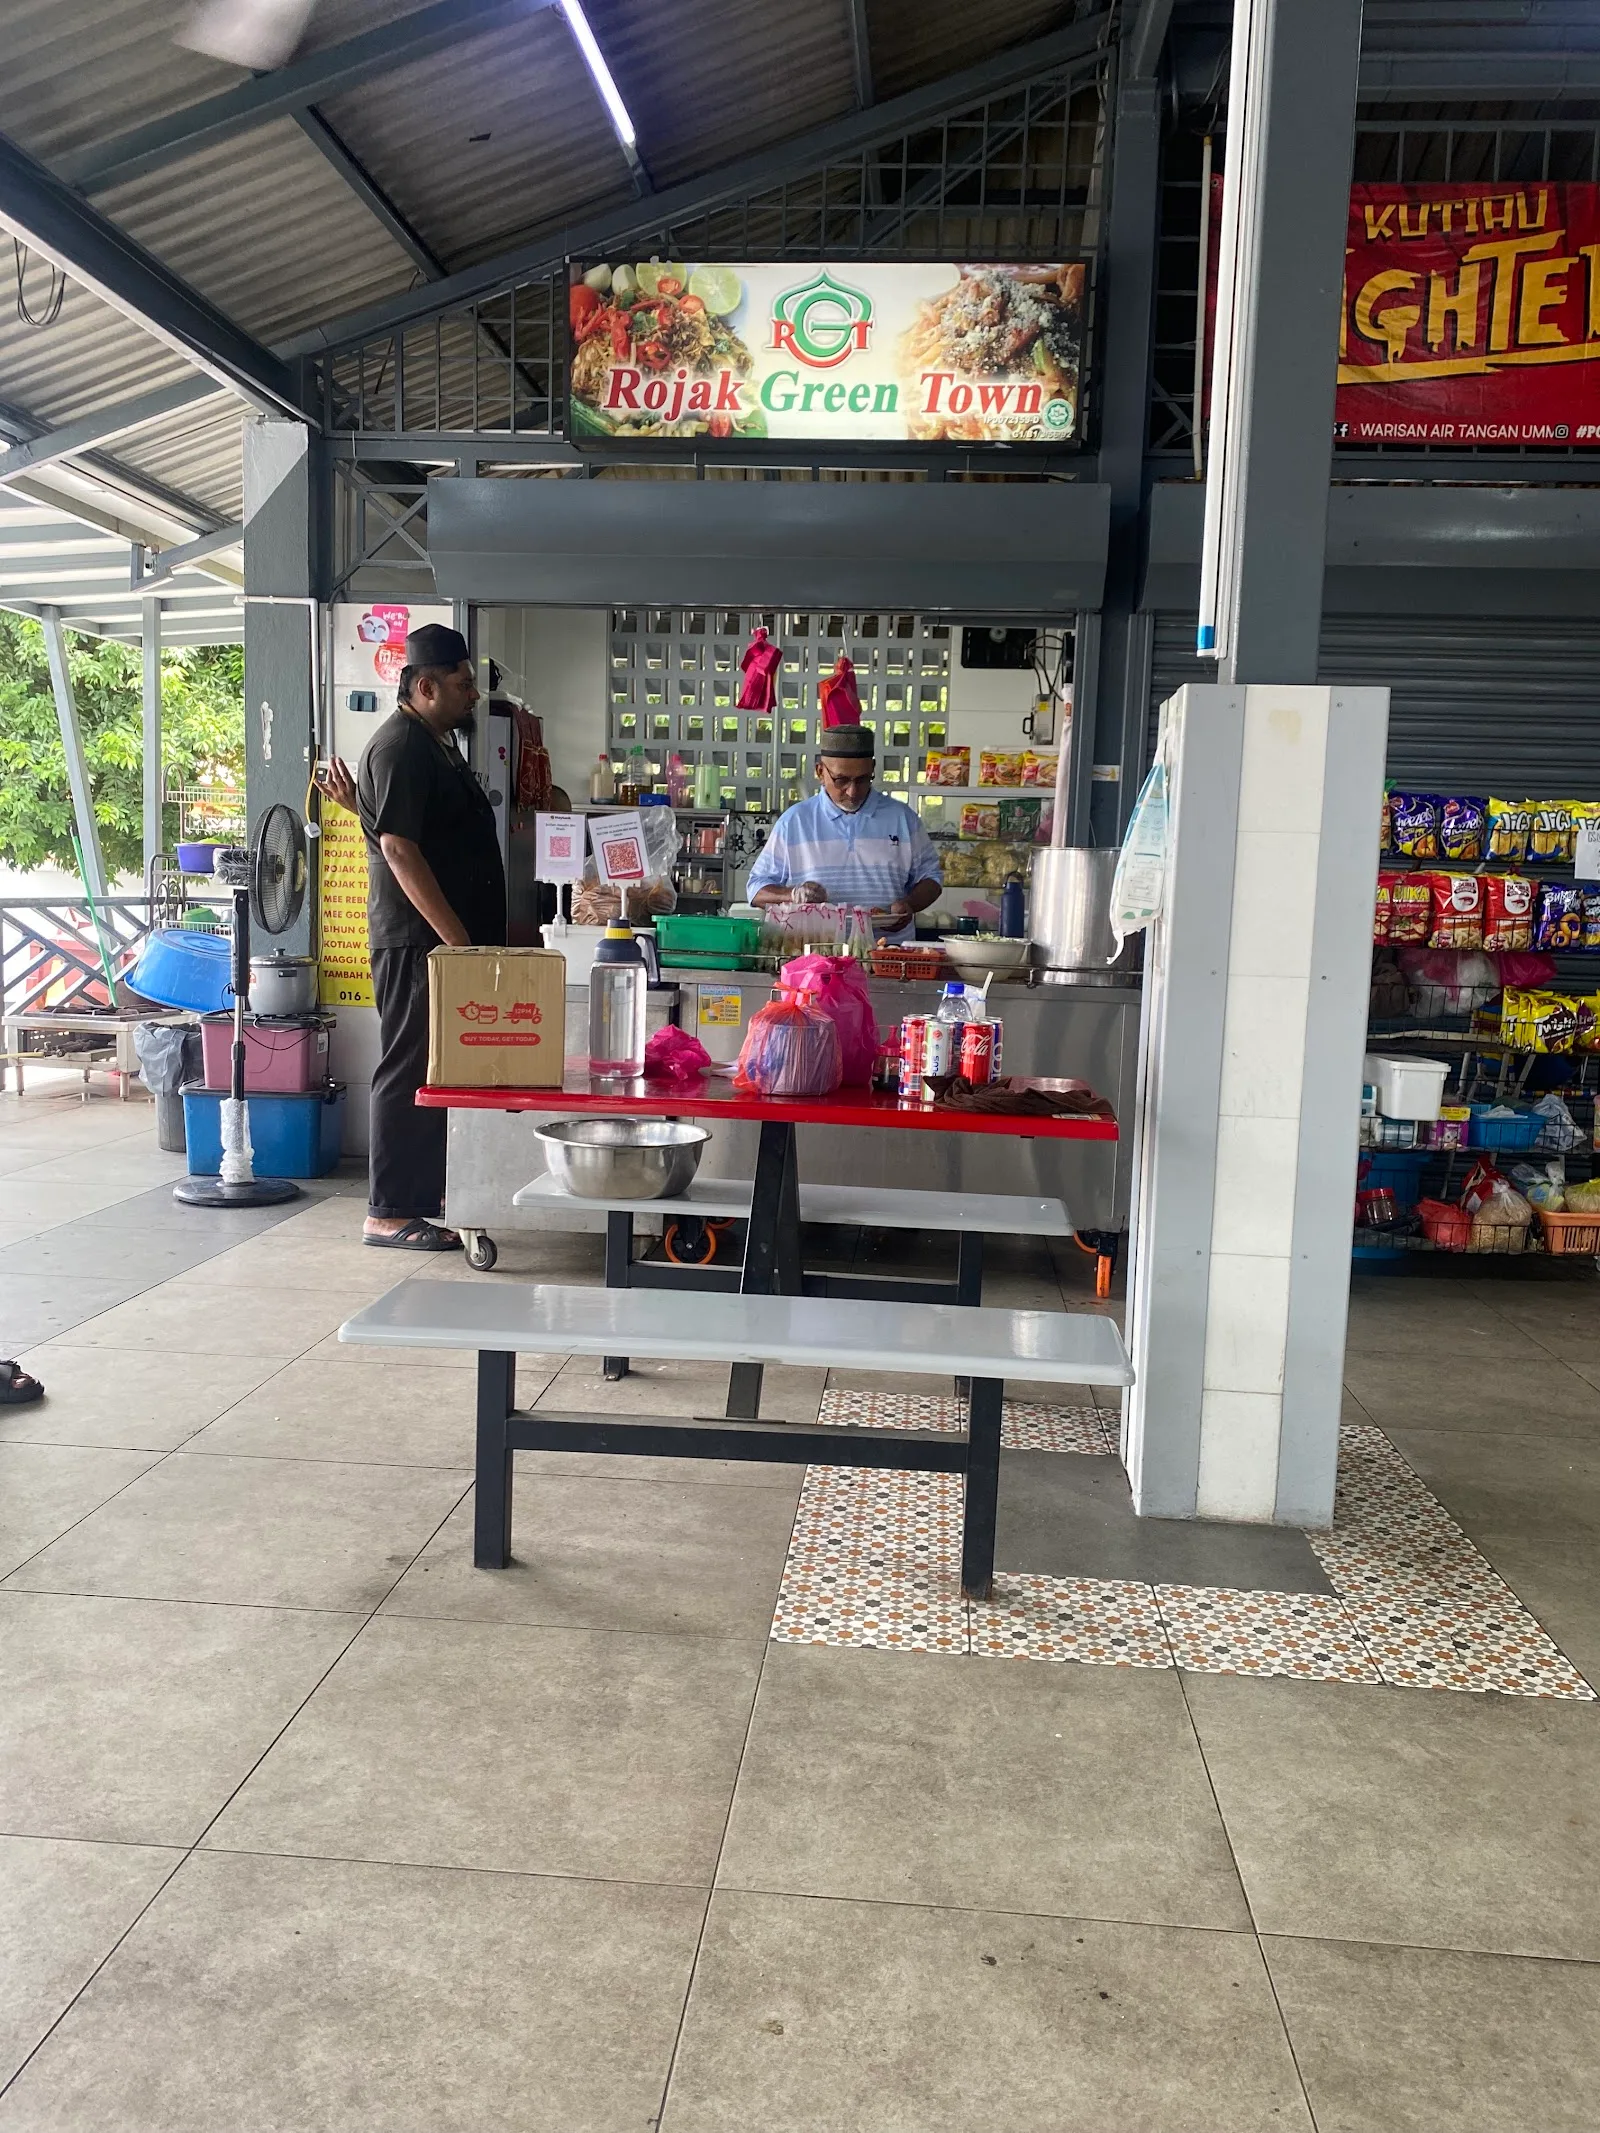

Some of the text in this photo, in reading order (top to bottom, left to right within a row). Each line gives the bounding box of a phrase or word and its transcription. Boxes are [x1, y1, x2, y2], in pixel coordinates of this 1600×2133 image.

[1364, 189, 1548, 240] KUTIAU
[603, 369, 1043, 422] Rojak Green Town
[1361, 423, 1428, 437] WARISAN
[1430, 423, 1455, 438] AIR
[1459, 424, 1518, 438] TANGAN
[324, 834, 355, 842] ROJAK
[324, 850, 355, 858] ROJAK
[324, 865, 355, 873] ROJAK
[324, 880, 355, 888] ROJAK
[324, 895, 342, 903] MEE
[324, 925, 355, 933] BIHUN
[324, 940, 361, 949] KOTIAW
[324, 956, 356, 964] MAGGI
[323, 971, 362, 979] TAMBAH
[339, 991, 361, 1001] 016
[961, 1033, 991, 1056] Cola
